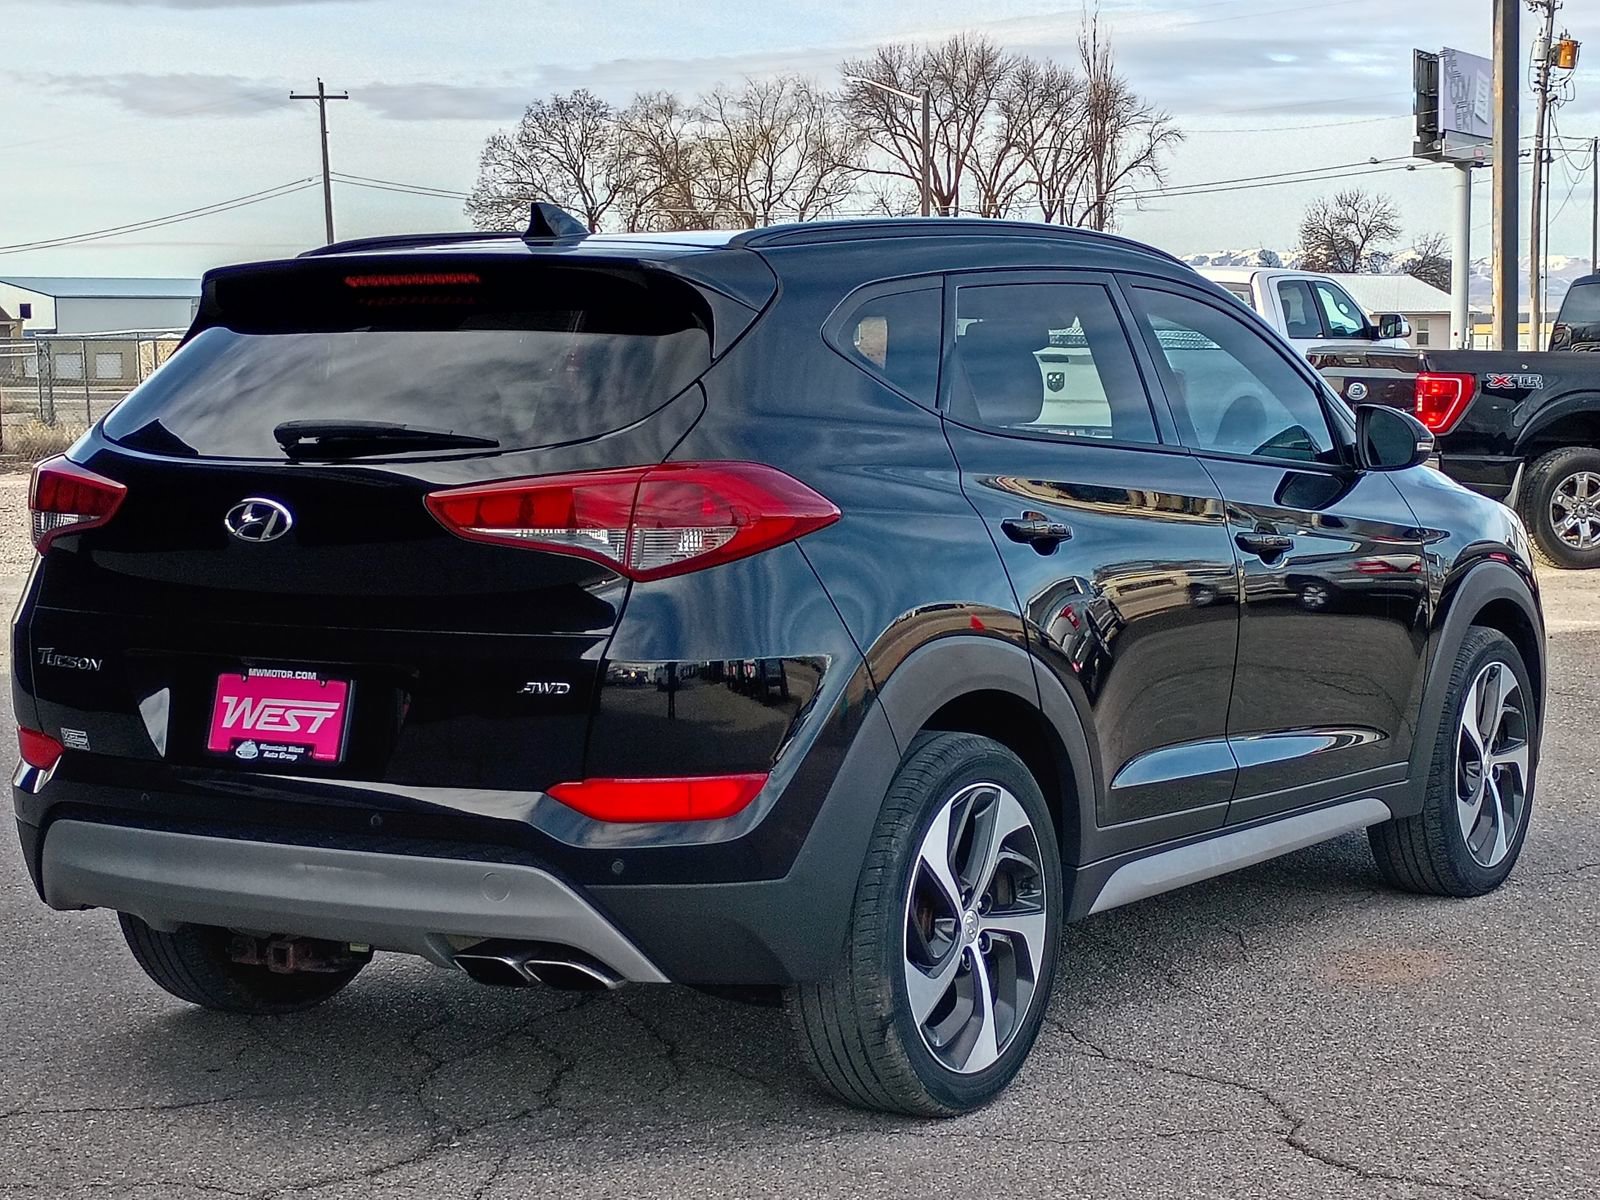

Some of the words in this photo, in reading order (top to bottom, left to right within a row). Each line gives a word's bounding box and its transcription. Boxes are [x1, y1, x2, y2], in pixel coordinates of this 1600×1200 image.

[1486, 373, 1544, 389] XTR
[249, 668, 317, 680] MWMOTOR.COM
[517, 682, 571, 694] AWD
[222, 696, 340, 733] WEST
